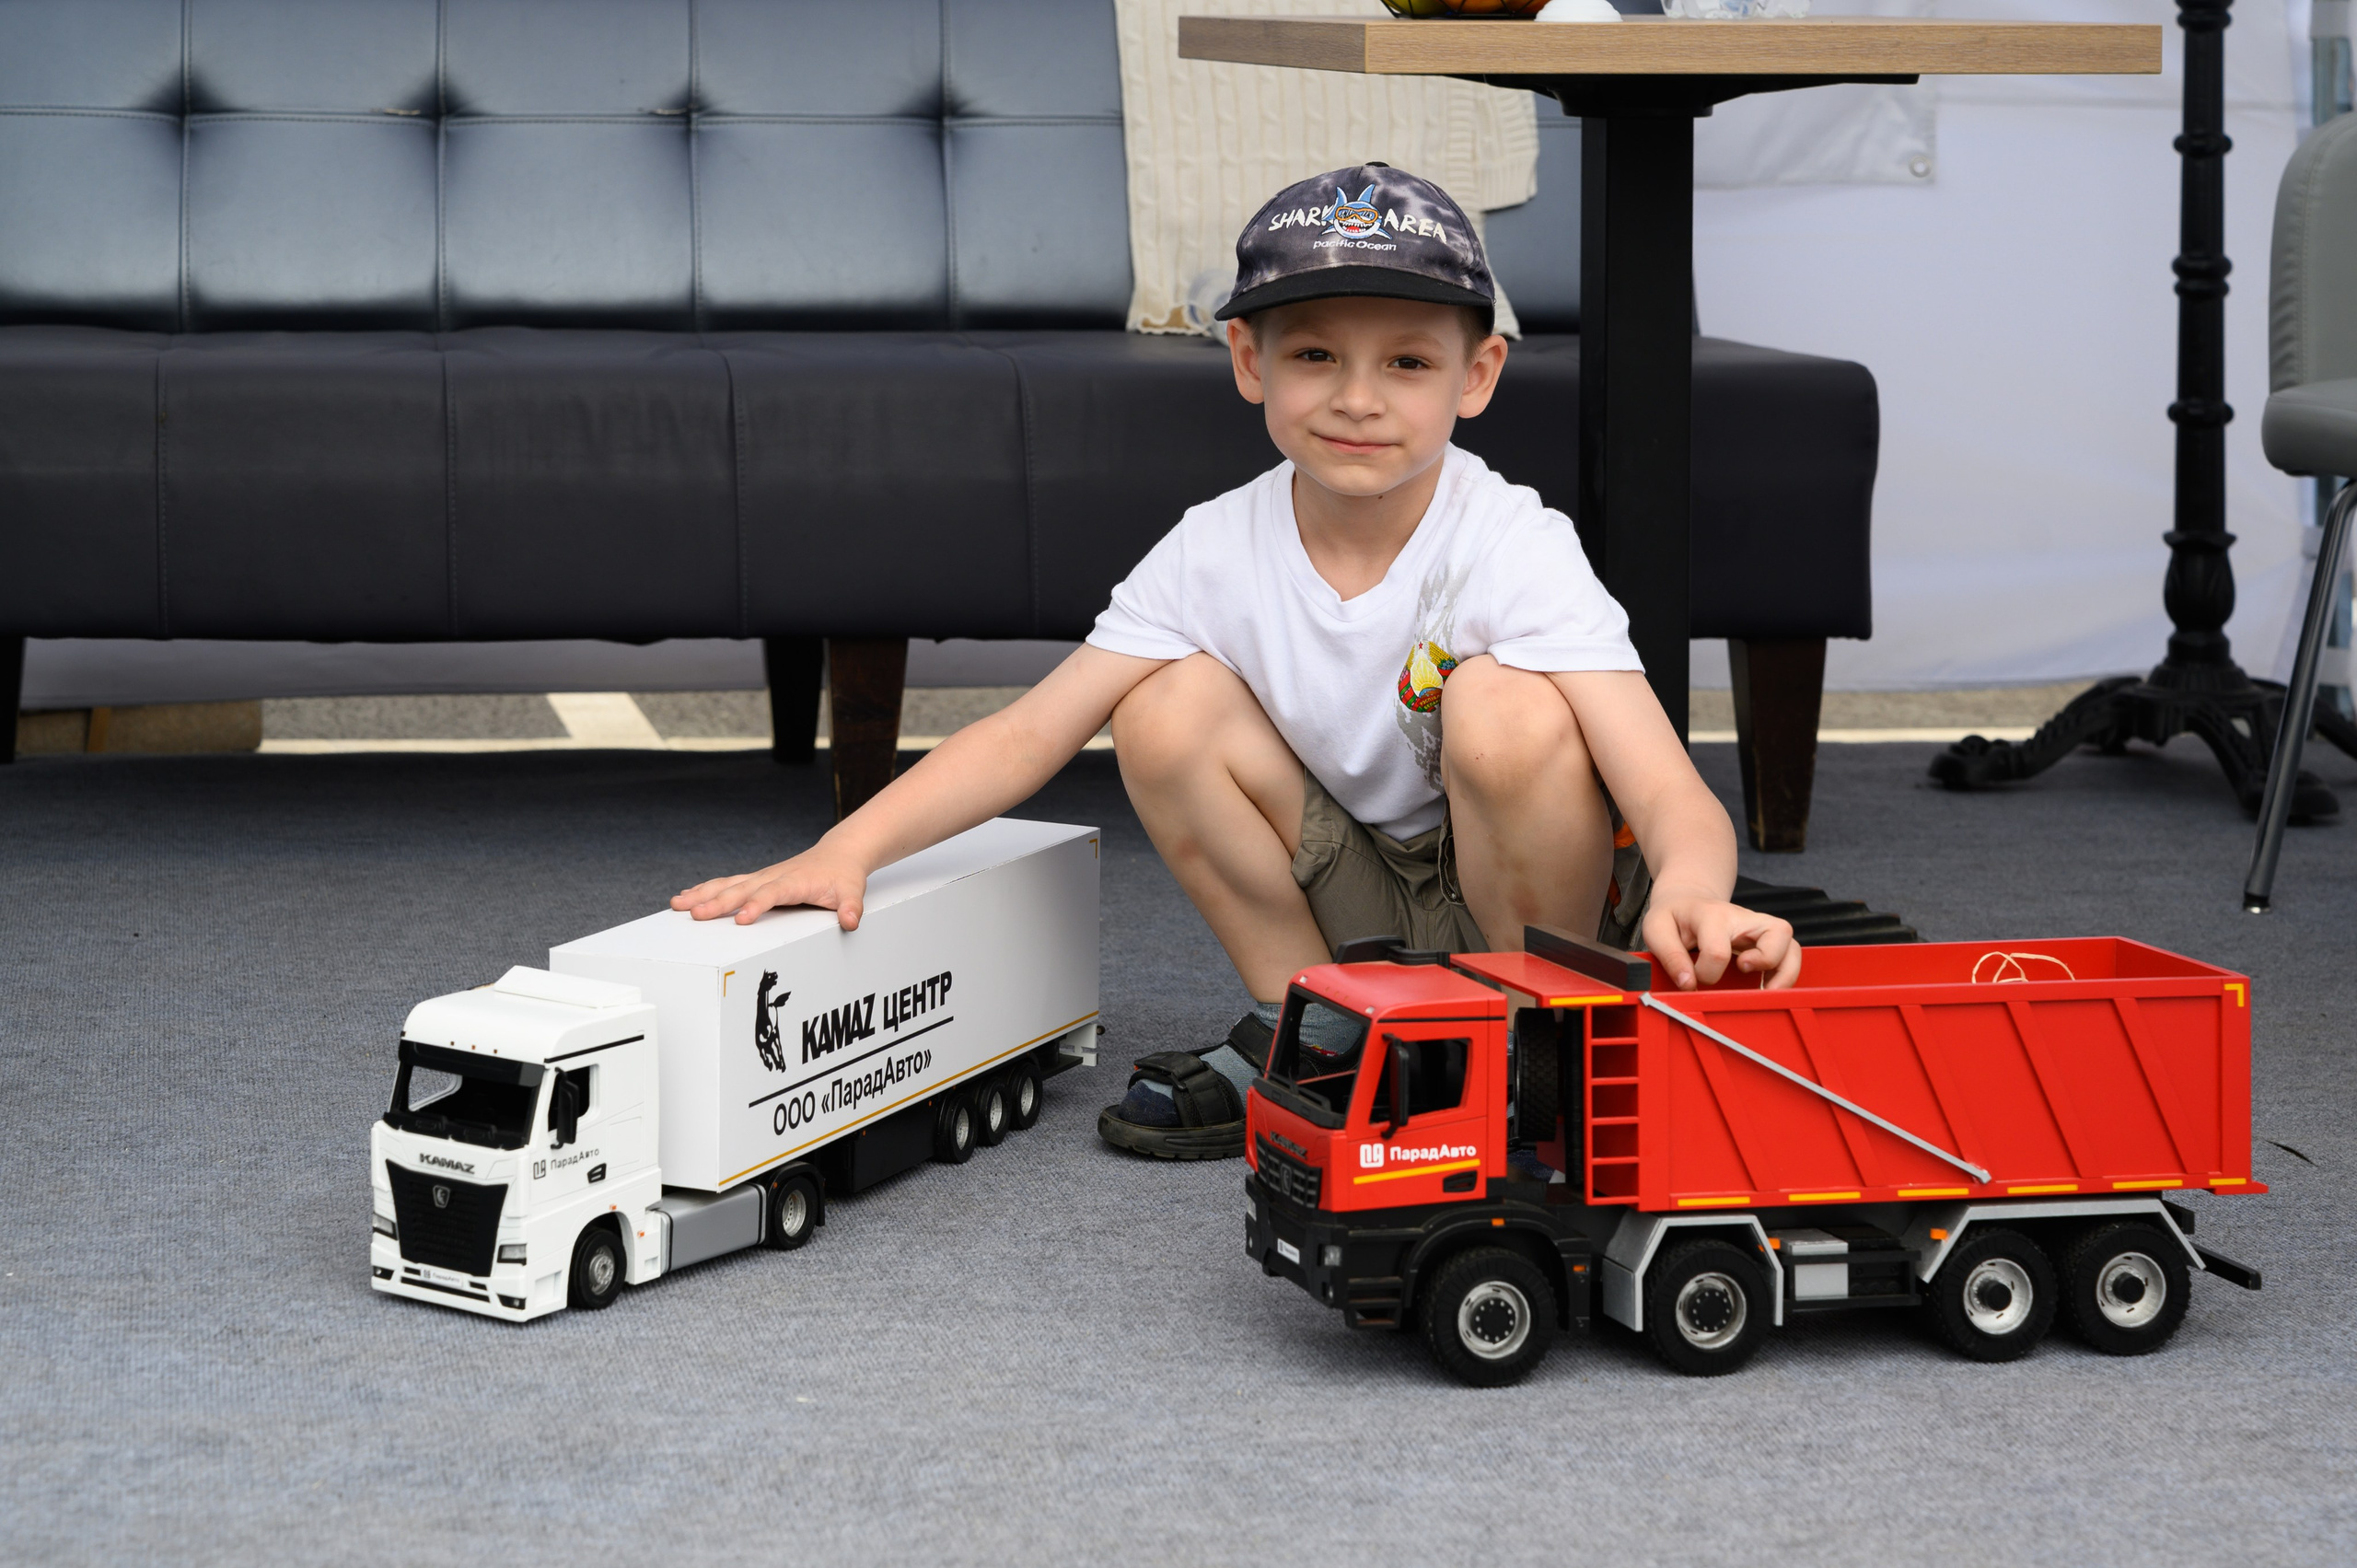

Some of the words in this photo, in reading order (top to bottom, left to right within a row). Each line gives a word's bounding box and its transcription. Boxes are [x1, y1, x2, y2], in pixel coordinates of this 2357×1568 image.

[1383, 208, 1446, 244] AREA
[1356, 240, 1397, 251] Ocean
[802, 993, 876, 1064] KAMAZ
[883, 970, 952, 1032] ЦЕНТР
[773, 1090, 816, 1136] ООО
[821, 1048, 932, 1115] «ПарадАвто»
[420, 1153, 475, 1175] KAMAZ
[551, 1148, 599, 1169] ПарадАвто
[1389, 1144, 1477, 1162] ПарадАвто
